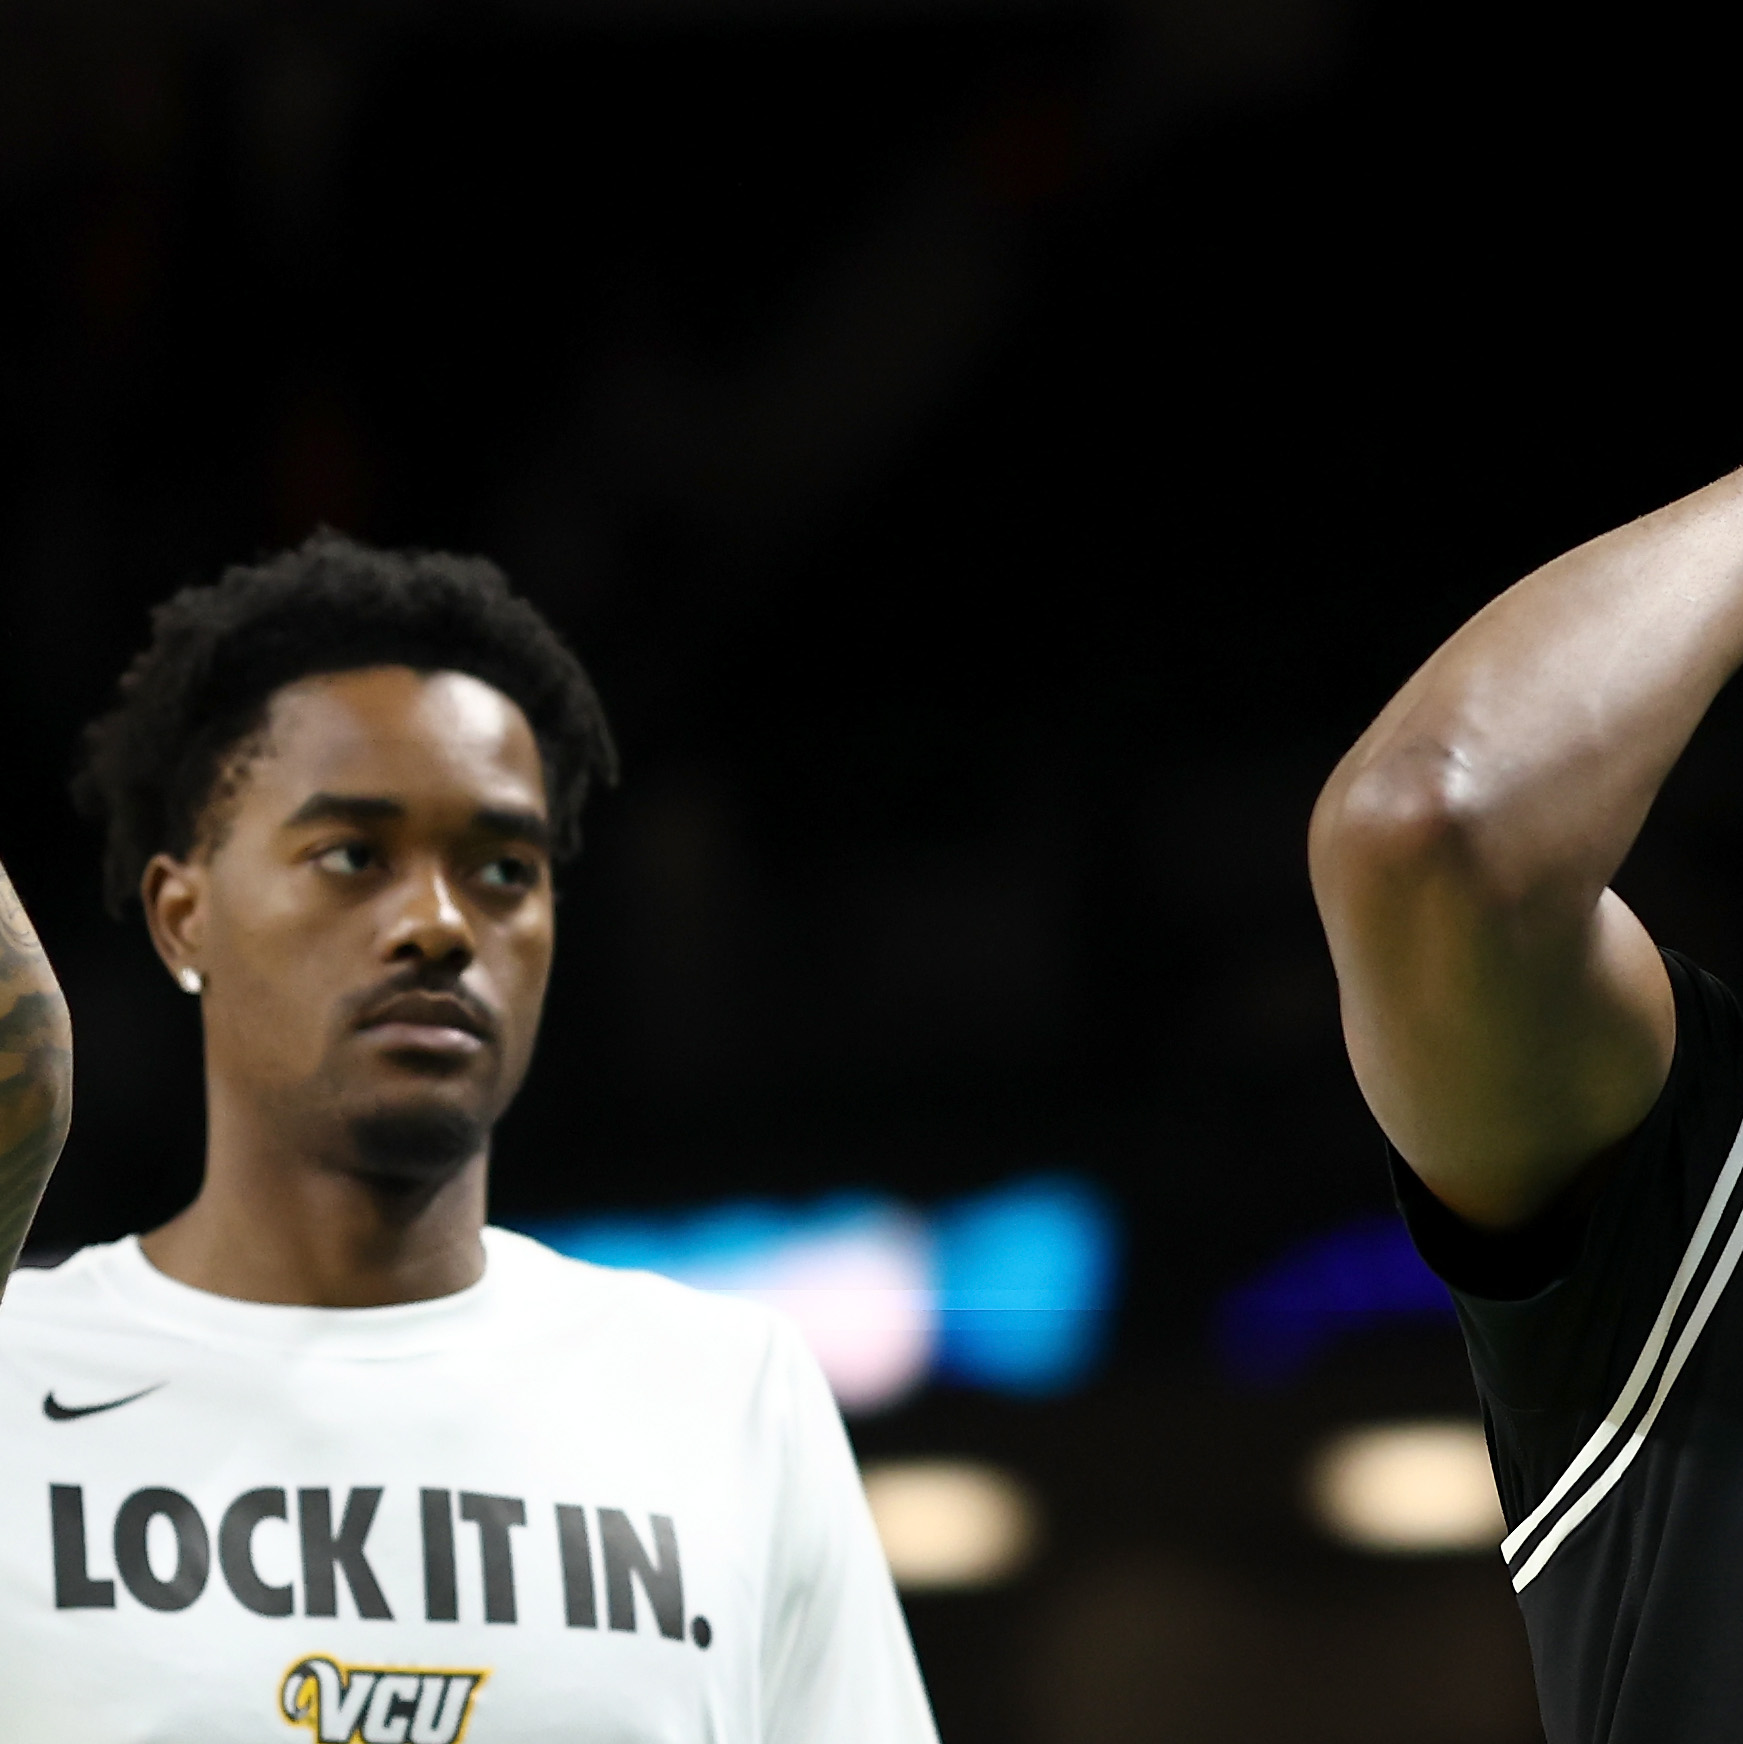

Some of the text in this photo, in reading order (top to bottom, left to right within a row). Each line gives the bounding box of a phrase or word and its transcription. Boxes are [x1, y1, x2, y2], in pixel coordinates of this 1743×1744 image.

[49, 1483, 713, 1649] LOCK IT IN.
